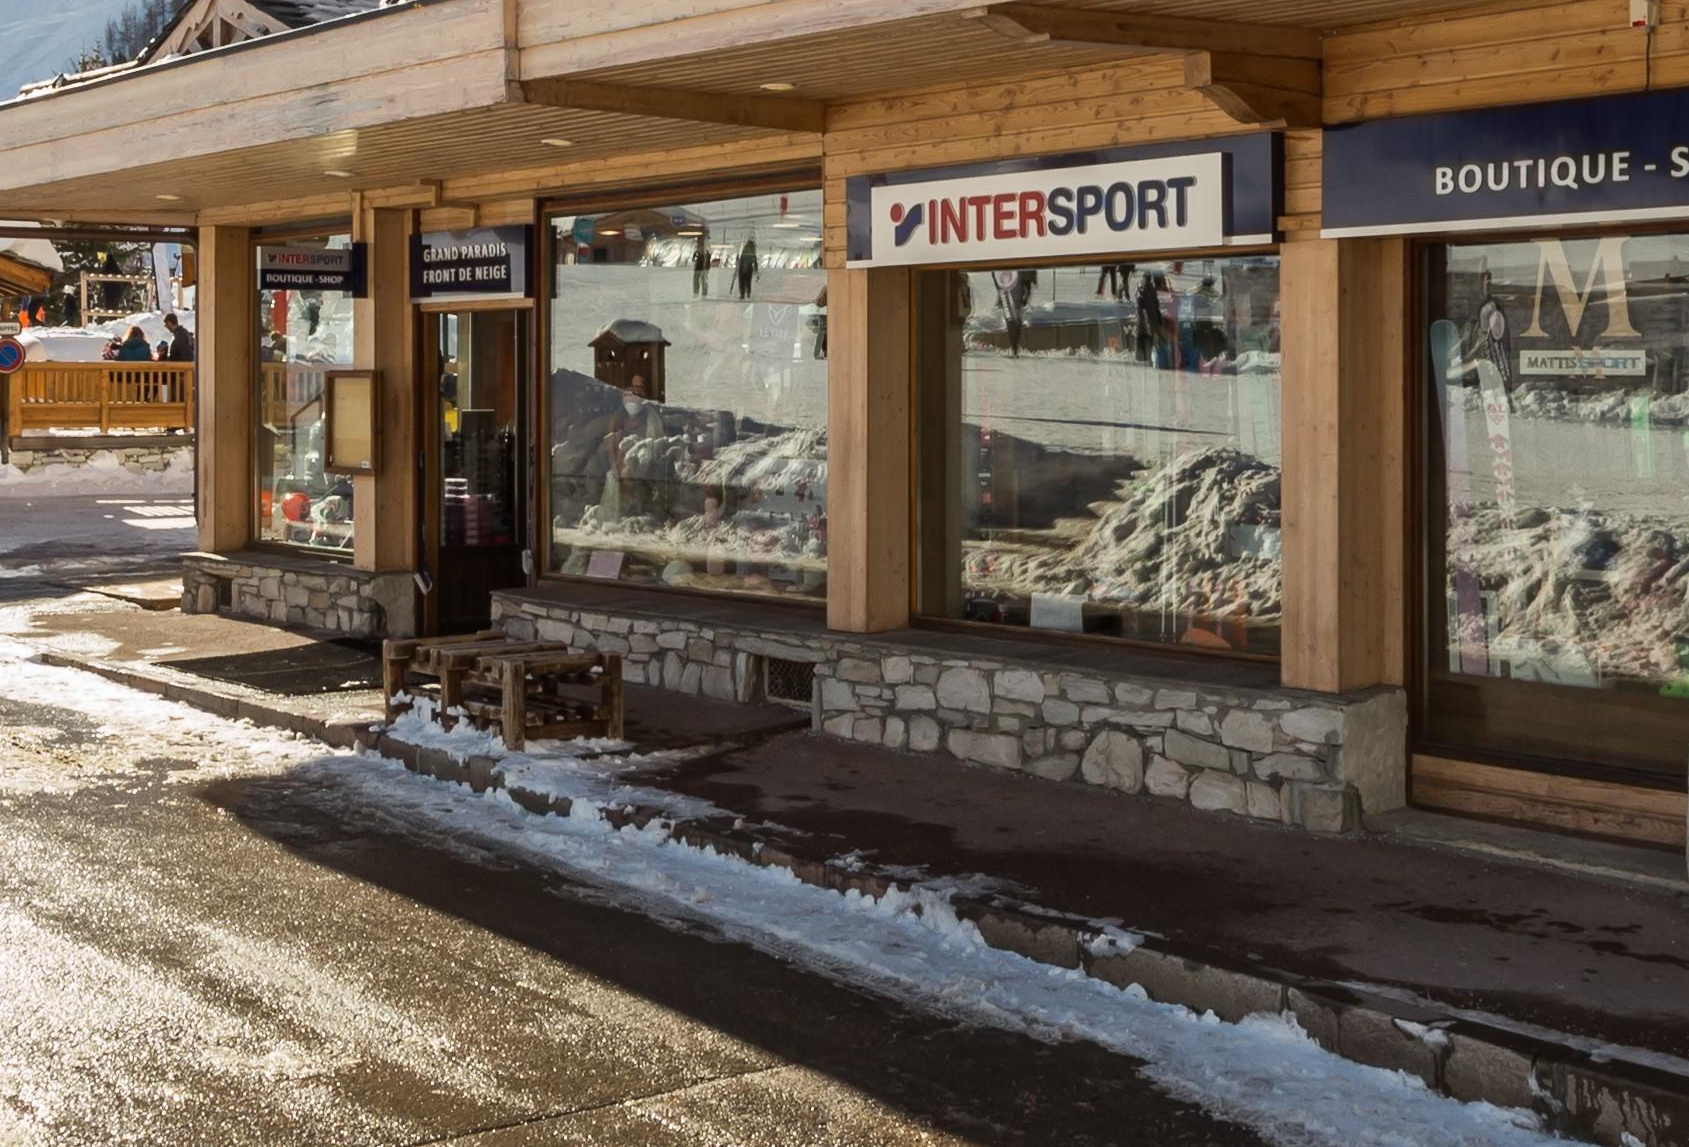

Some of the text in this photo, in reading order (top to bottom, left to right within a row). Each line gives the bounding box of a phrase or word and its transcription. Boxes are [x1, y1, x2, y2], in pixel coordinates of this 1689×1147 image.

[1435, 151, 1630, 195] BOUTIQUE
[928, 176, 1197, 245] INTERSPORT
[277, 253, 344, 265] INTERSPORT
[423, 242, 507, 263] GRAND PARADIS
[266, 273, 313, 284] BOUTIQUE
[319, 275, 344, 284] SHOP
[423, 264, 507, 284] FRONT DE NEIGE
[1519, 236, 1642, 337] M
